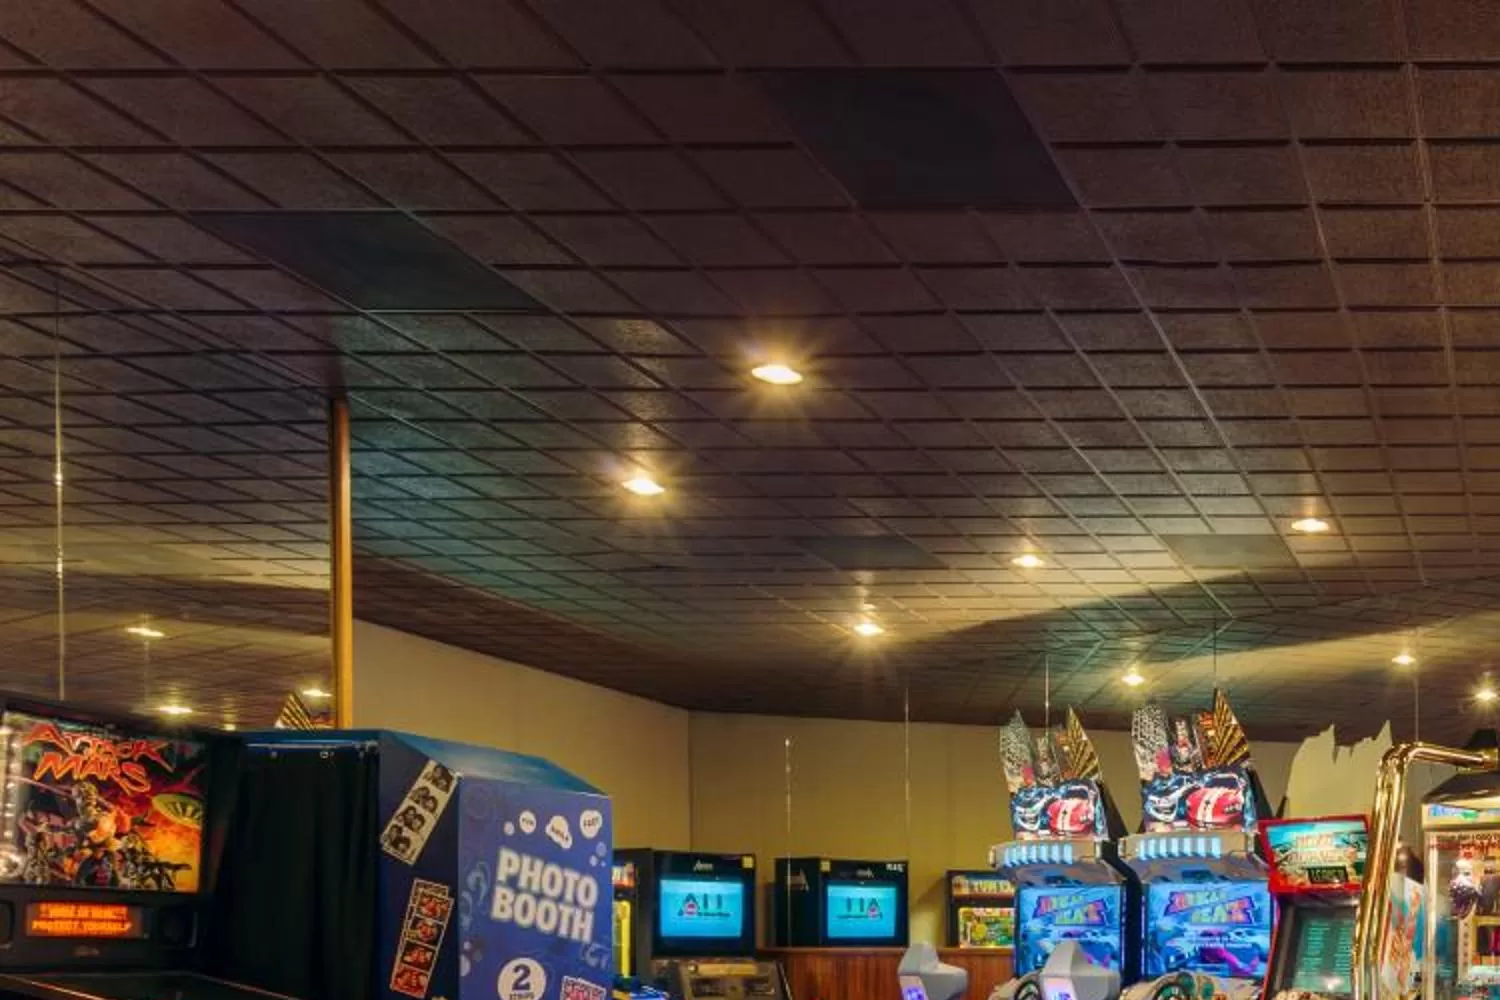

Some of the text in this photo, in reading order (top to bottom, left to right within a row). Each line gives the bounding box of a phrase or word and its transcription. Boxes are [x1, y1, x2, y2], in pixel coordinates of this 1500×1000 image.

[24, 723, 174, 772] ATTACK
[33, 751, 151, 796] MARS
[497, 847, 598, 909] PHOTO
[491, 885, 593, 944] BOOTH
[512, 964, 531, 990] 2
